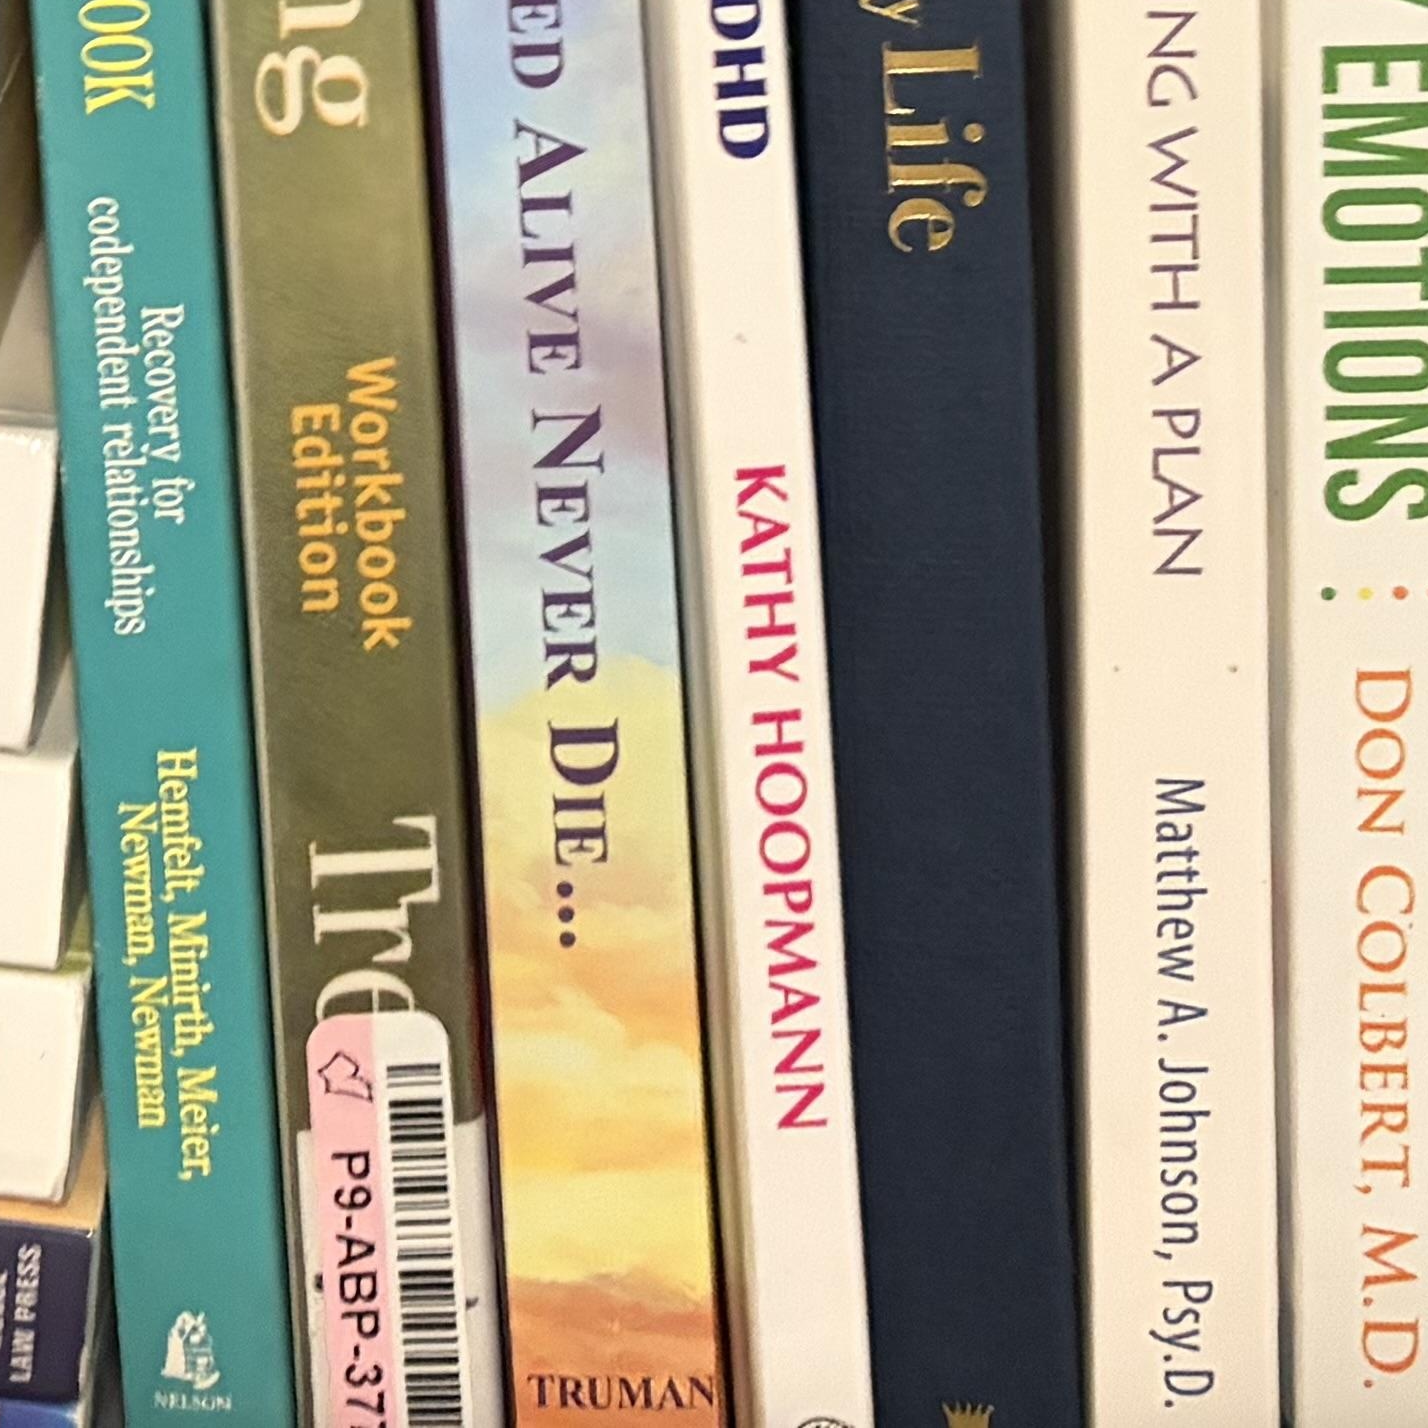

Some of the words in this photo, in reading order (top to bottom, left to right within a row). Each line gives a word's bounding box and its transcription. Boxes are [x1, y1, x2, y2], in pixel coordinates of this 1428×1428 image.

[883, 40, 987, 253] Life
[1148, 127, 1200, 311] WITH
[84, 196, 140, 411] codependent
[512, 118, 588, 376] ALIVE
[1322, 44, 1428, 521] EMOTIONS
[140, 303, 185, 464] Recovery
[1151, 335, 1201, 386] A
[103, 421, 157, 635] relationships
[152, 475, 196, 525] for
[290, 403, 349, 614] Edition
[347, 356, 413, 652] Workbook
[531, 404, 605, 690] NEVER
[734, 465, 800, 683] KATHY
[1151, 408, 1202, 576] PLAN
[156, 747, 198, 903] Hemfelt,
[1354, 668, 1413, 837] DON
[118, 801, 156, 966] Newman,
[752, 708, 828, 1130] HOOPMANN
[1153, 778, 1209, 983] Matthew
[128, 974, 166, 1128] Newman
[168, 909, 215, 1058] Minirth,
[1157, 998, 1209, 1044] A.
[1354, 864, 1416, 1195] COLBERT,
[176, 1064, 217, 1182] Meier,
[1153, 1058, 1211, 1260] Johnson,
[9, 1328, 35, 1383] LAW
[14, 1244, 42, 1322] PRESS
[331, 1151, 387, 1428] P9-ABP-37
[1150, 1279, 1214, 1408] Psy.D.
[1360, 1223, 1419, 1389] M.D.
[153, 1391, 232, 1411] NELSON
[527, 1374, 714, 1410] TRUMAN
